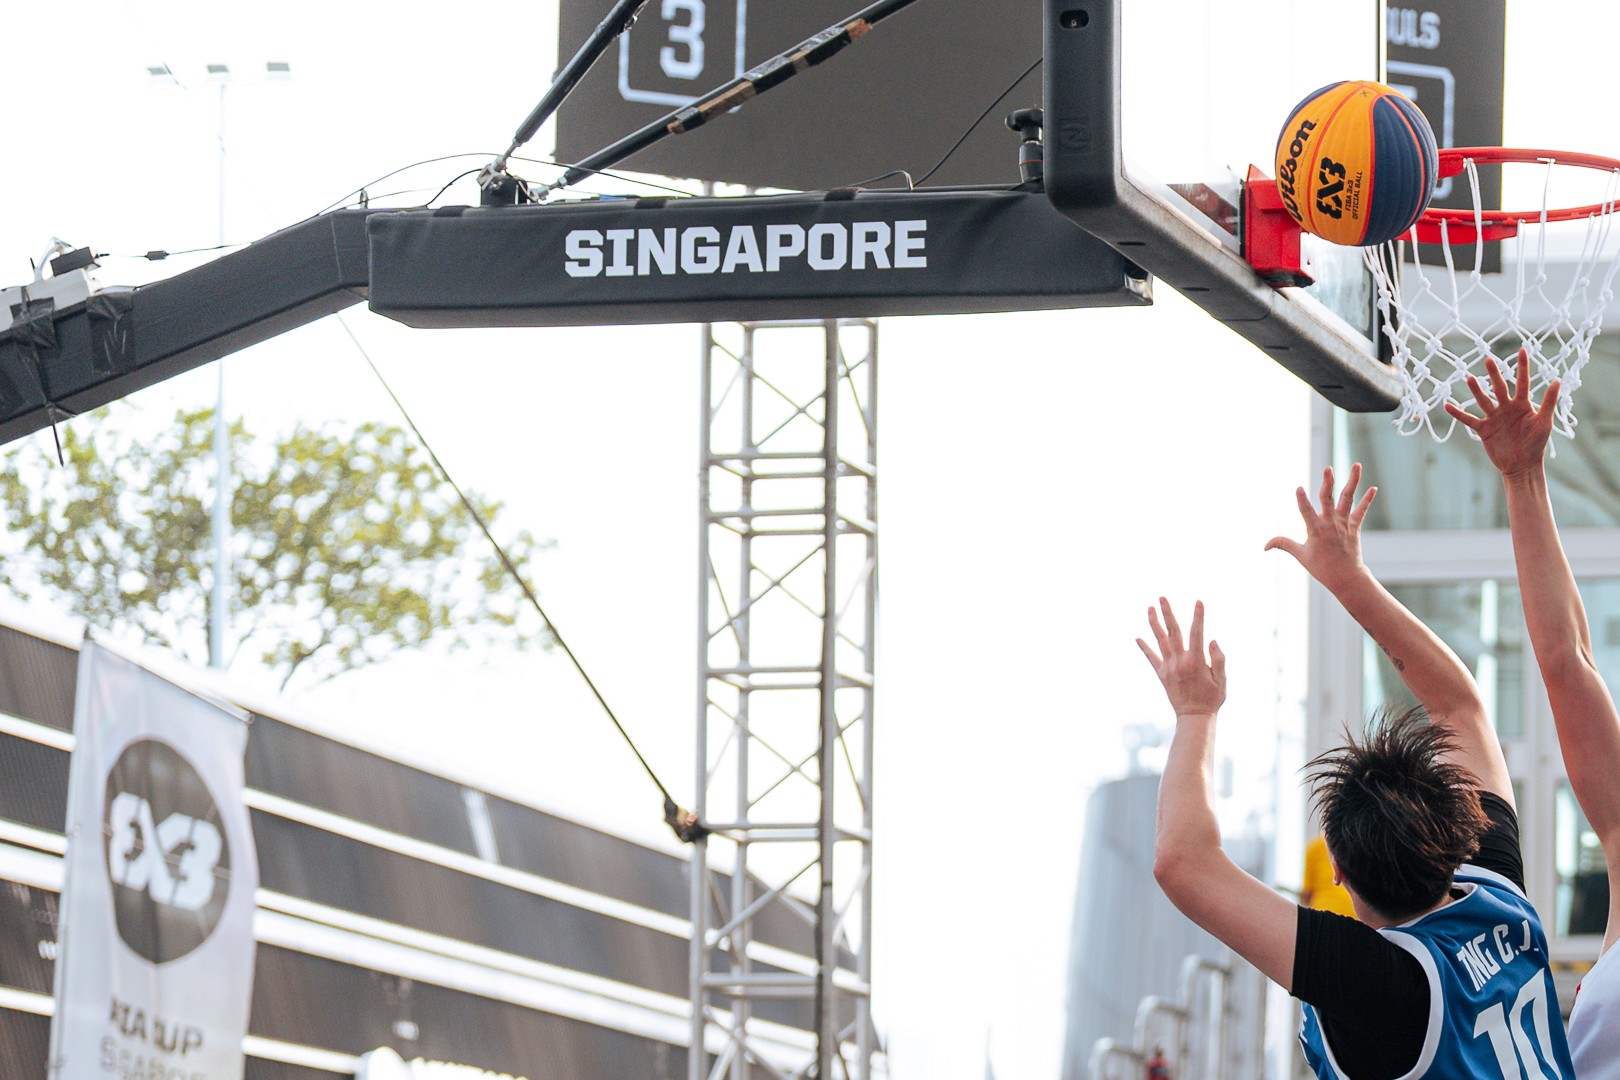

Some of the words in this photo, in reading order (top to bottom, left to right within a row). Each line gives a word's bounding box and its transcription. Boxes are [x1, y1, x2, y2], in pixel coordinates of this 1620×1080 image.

[660, 0, 705, 80] 3
[1387, 6, 1441, 50] ULS
[1280, 119, 1319, 222] Wilson
[1354, 171, 1363, 189] BALL
[1351, 190, 1360, 220] OFFICIAL
[564, 219, 928, 278] SINGAPORE
[1493, 923, 1519, 964] C.
